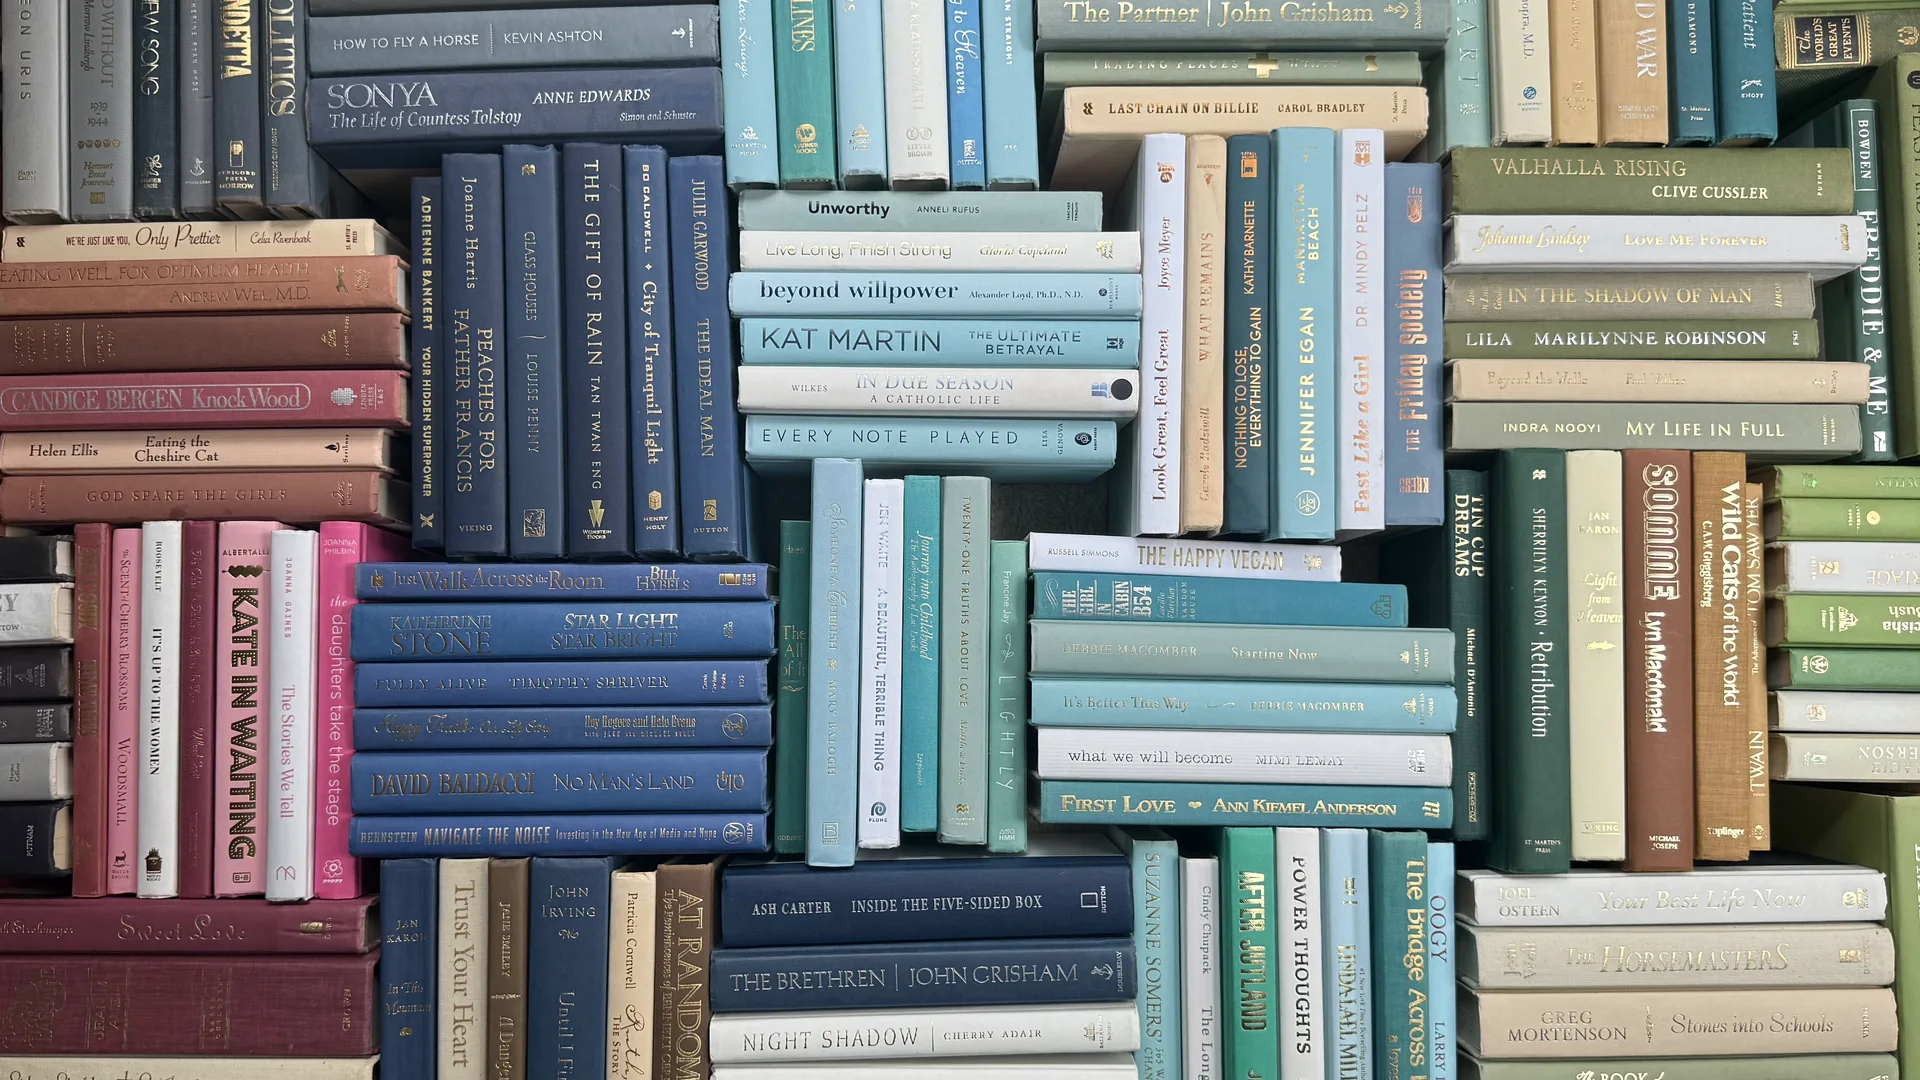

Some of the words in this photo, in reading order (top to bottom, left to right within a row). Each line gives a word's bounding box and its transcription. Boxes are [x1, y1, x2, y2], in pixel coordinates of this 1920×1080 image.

[333, 39, 366, 50] HOW
[371, 38, 389, 49] TO
[394, 37, 416, 48] FLY
[419, 36, 428, 47] A
[433, 34, 480, 46] HORSE
[504, 31, 543, 44] KEVIN
[547, 30, 603, 43] ASHTON
[1799, 29, 1811, 54] The
[1815, 18, 1823, 62] WORLD'S
[1829, 22, 1837, 58] GREAT
[1843, 18, 1851, 60] EVENTS
[90, 102, 107, 111] 1939
[327, 81, 438, 109] SONYA
[532, 91, 574, 105] ANNE
[579, 88, 651, 104] EDWARDS
[1109, 103, 1143, 114] LAST
[1147, 103, 1188, 114] CHAIN
[1193, 103, 1209, 114] ON
[1214, 102, 1259, 114] BILLIE
[1278, 104, 1313, 113] CAROL
[1316, 103, 1366, 113] BRADLEY
[88, 117, 108, 126] 1944
[329, 113, 357, 129] The
[361, 112, 385, 130] Life
[390, 110, 404, 127] of
[407, 109, 470, 127] Countess
[472, 109, 521, 127] Tolstoy
[619, 112, 641, 122] Simon
[643, 111, 662, 121] and
[663, 110, 696, 121] Schuster
[1858, 119, 1872, 179] BOWDEN
[584, 160, 599, 203] THE
[1491, 158, 1605, 176] VALHALLA
[1614, 160, 1687, 177] RISING
[462, 178, 477, 232] Joanne
[1652, 186, 1698, 199] CLIVE
[1703, 186, 1768, 199] CUSSLER
[808, 201, 890, 218] Unworthy
[917, 205, 949, 214] ANNELI
[952, 205, 980, 214] RUFUS
[66, 236, 85, 247] WE'RE
[86, 236, 101, 246] JUST
[102, 236, 116, 246] LIKE
[116, 235, 130, 247] YOU,
[136, 226, 168, 250] Only
[174, 223, 221, 248] Prettier
[250, 231, 271, 244] Celia
[272, 230, 312, 244] Rivenbark
[421, 195, 432, 265] ADRIENNE
[584, 213, 601, 263] GIFT
[1158, 216, 1174, 255] Meyer
[1244, 200, 1255, 255] BARNETTE
[465, 237, 480, 289] Harris
[1158, 259, 1170, 290] Joyce
[1243, 258, 1255, 295] KATHY
[422, 270, 433, 331] BANKERT
[586, 274, 602, 301] OF
[760, 280, 839, 303] beyond
[849, 280, 959, 303] willpower
[969, 290, 1010, 298] Alexander
[1012, 290, 1034, 300] Loyd,
[1036, 290, 1061, 300] Ph.D.,
[1064, 290, 1084, 298] N.D.
[586, 312, 603, 364] RAIN
[1300, 307, 1315, 364] EGAN
[422, 347, 431, 376] YOUR
[423, 379, 431, 422] HIDDEN
[763, 428, 832, 443] EVERY
[852, 428, 907, 443] NOTE
[930, 430, 1017, 445] PLAYED
[1300, 373, 1315, 475] JENNIFER
[1504, 424, 1548, 433] INDRA
[1555, 424, 1600, 433] NOOYI
[1626, 421, 1655, 436] MY
[1664, 422, 1701, 436] LIFE
[1711, 422, 1731, 436] IN
[1741, 423, 1784, 437] FULL
[29, 444, 67, 457] Helen
[71, 443, 98, 456] Ellis
[134, 449, 191, 462] Cheshire
[195, 450, 219, 462] Cat
[145, 435, 186, 450] Eating
[190, 435, 210, 447] the
[342, 433, 350, 462] Scribner
[423, 424, 432, 497] SUPERPOWER
[459, 524, 493, 532] VIKING
[1048, 548, 1079, 557] RUSSELL
[1081, 549, 1119, 558] SIMMONS
[1137, 545, 1169, 566] THE
[1173, 547, 1225, 569] HAPPY
[1231, 549, 1284, 571] VEGAN
[329, 595, 348, 607] the
[231, 588, 259, 667] KATE
[1640, 611, 1665, 643] Lyn
[329, 614, 347, 699] daughters
[1466, 627, 1475, 665] Michael
[231, 676, 258, 708] IN
[1467, 668, 1476, 717] D'Antonio
[1644, 645, 1667, 732] Macdonald
[329, 705, 344, 740] take
[329, 745, 344, 774] the
[1068, 750, 1106, 763] what
[1112, 752, 1133, 763] we
[1139, 750, 1169, 764] will
[1175, 751, 1232, 764] become
[1749, 730, 1764, 793] TWAIN
[228, 715, 258, 860] WAITING
[371, 774, 431, 796] DAVID
[439, 772, 535, 796] BALDACCI
[326, 778, 342, 826] stage
[26, 825, 34, 857] PUTNAM
[424, 827, 482, 845] NAVIGATE
[488, 827, 509, 844] THE
[515, 826, 550, 843] NOISE
[1652, 842, 1678, 850] JOSEPH
[454, 880, 475, 939] Trust
[752, 902, 777, 916] ASH
[781, 901, 831, 915] CARTER
[851, 899, 898, 913] INSIDE
[902, 898, 929, 912] THE
[933, 896, 1011, 912] FIVE-SIDED
[1016, 895, 1042, 909] BOX
[1201, 885, 1212, 919] Cindy
[1292, 856, 1308, 931] POWER
[627, 892, 638, 935] Patricia
[1429, 895, 1447, 963] OOGY
[625, 938, 638, 989] Cornwell
[1200, 923, 1212, 974] Chupack
[453, 944, 475, 997] Your
[1294, 938, 1311, 1054] THOUGHTS
[453, 1002, 474, 1067] Heart
[743, 1031, 811, 1051] NIGHT
[821, 1027, 919, 1048] SHADOW
[943, 1030, 994, 1040] CHERRY
[1001, 1029, 1042, 1039] ADAIR
[1670, 1013, 1728, 1034] Stones
[1733, 1015, 1764, 1033] into
[1769, 1012, 1834, 1033] Schools
